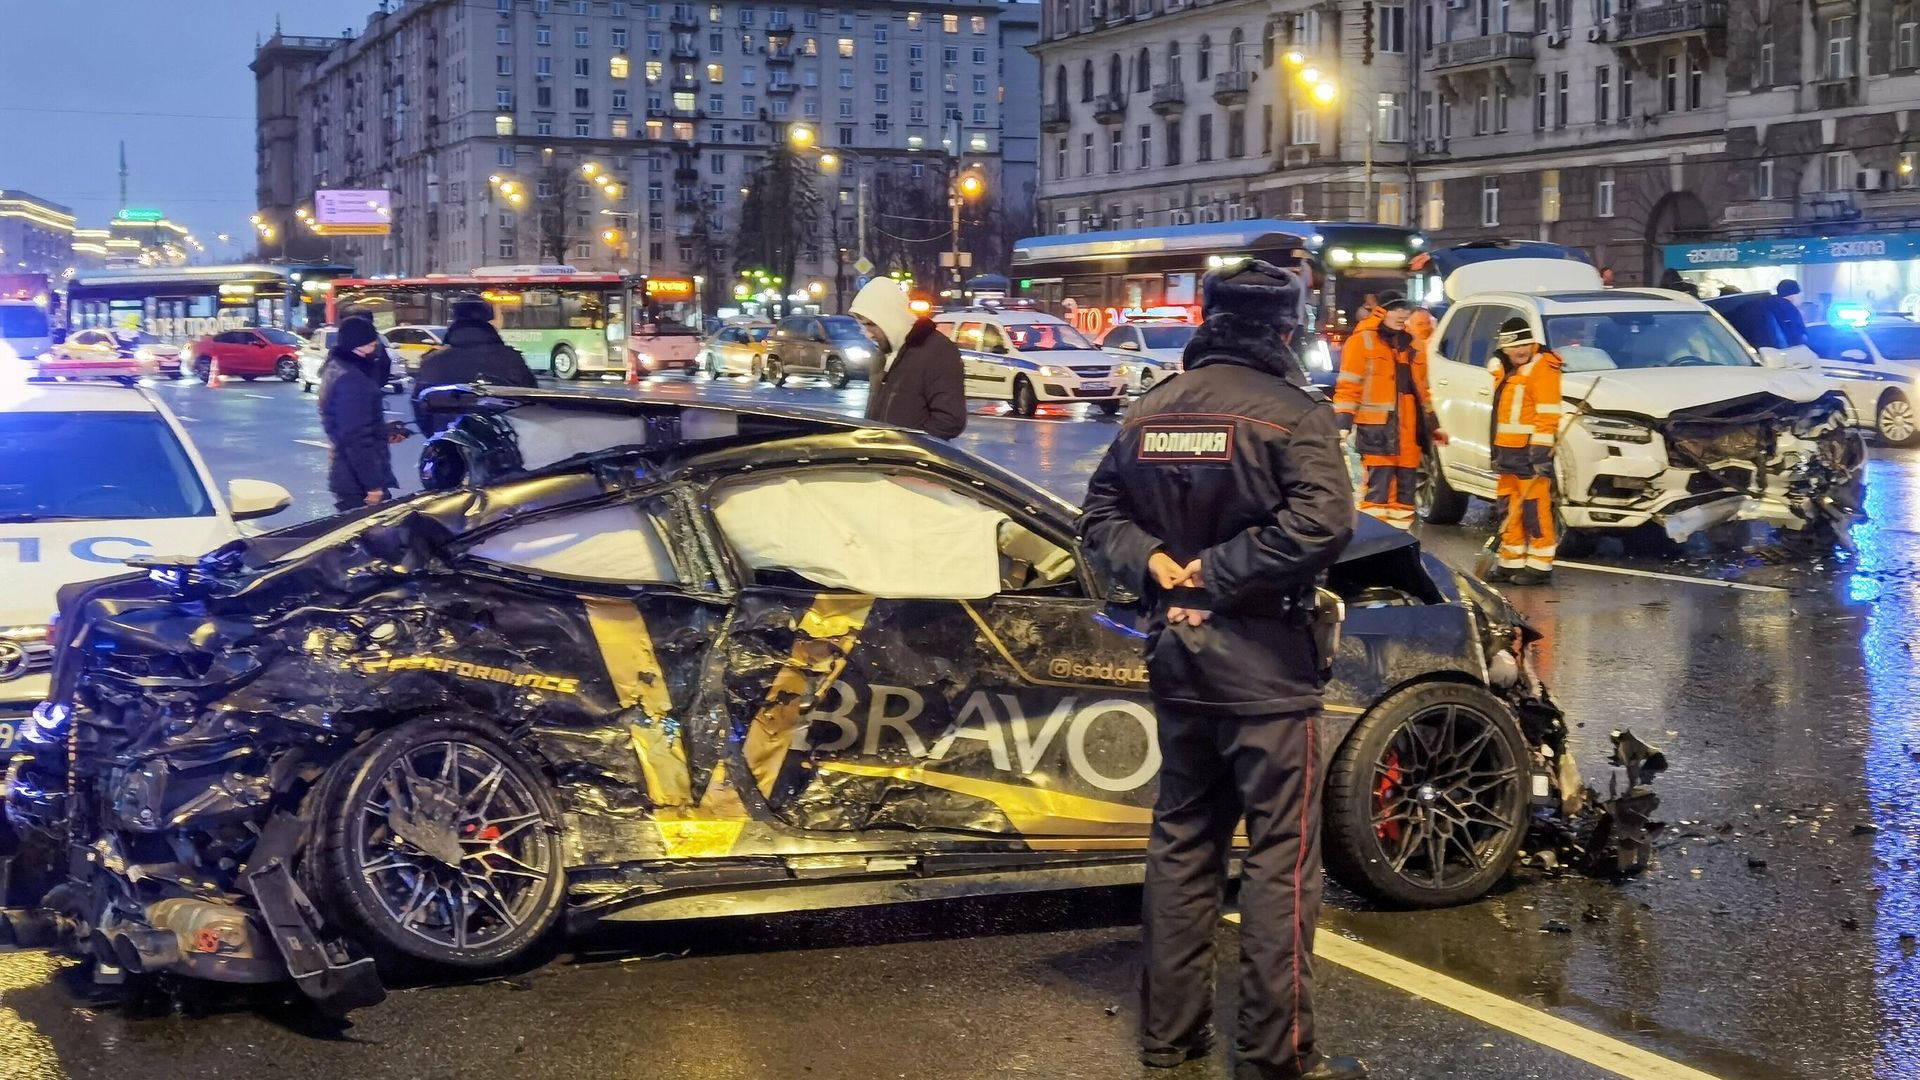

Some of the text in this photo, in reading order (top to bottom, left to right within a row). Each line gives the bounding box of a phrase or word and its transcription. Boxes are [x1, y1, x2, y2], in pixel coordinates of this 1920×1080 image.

[1689, 247, 1738, 263] askona
[1831, 240, 1885, 256] askona
[1143, 432, 1228, 456] ПОЛИЦИЯ
[789, 680, 1163, 792] BRAVO
